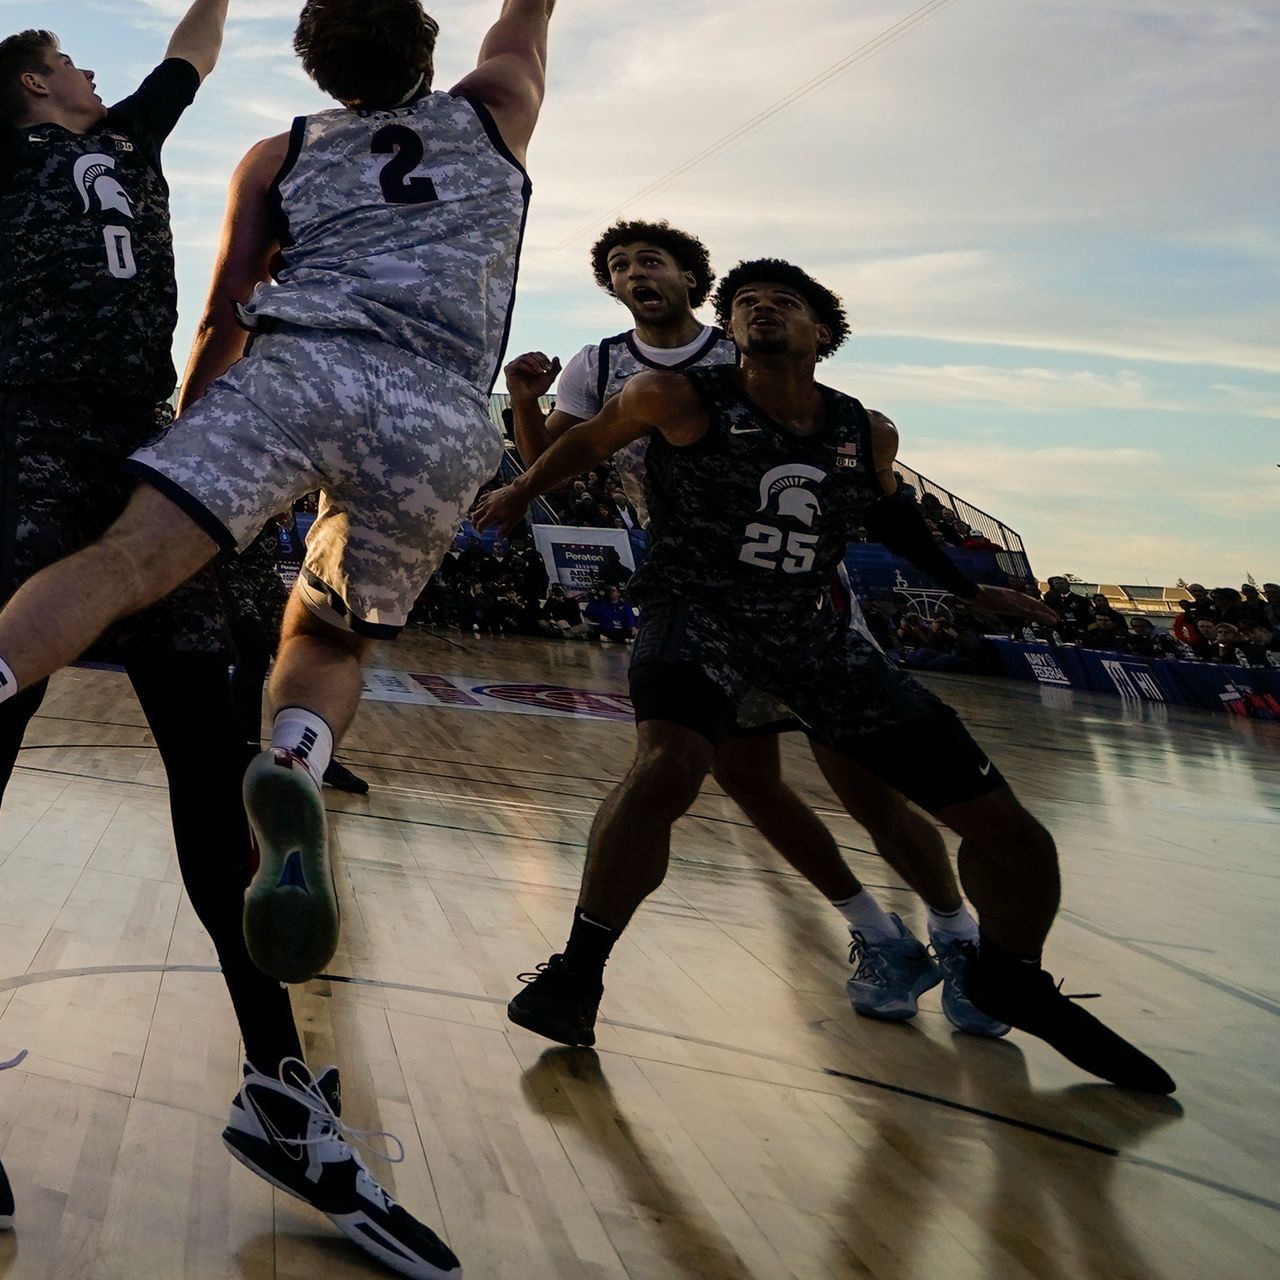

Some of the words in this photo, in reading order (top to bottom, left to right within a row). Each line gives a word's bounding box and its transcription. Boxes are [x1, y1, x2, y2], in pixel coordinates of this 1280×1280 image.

[371, 124, 438, 203] 2
[103, 224, 137, 279] 0
[565, 551, 604, 561] Peraton
[738, 521, 820, 574] 25
[1024, 652, 1049, 666] NAVY
[1031, 665, 1069, 681] FEDERAL
